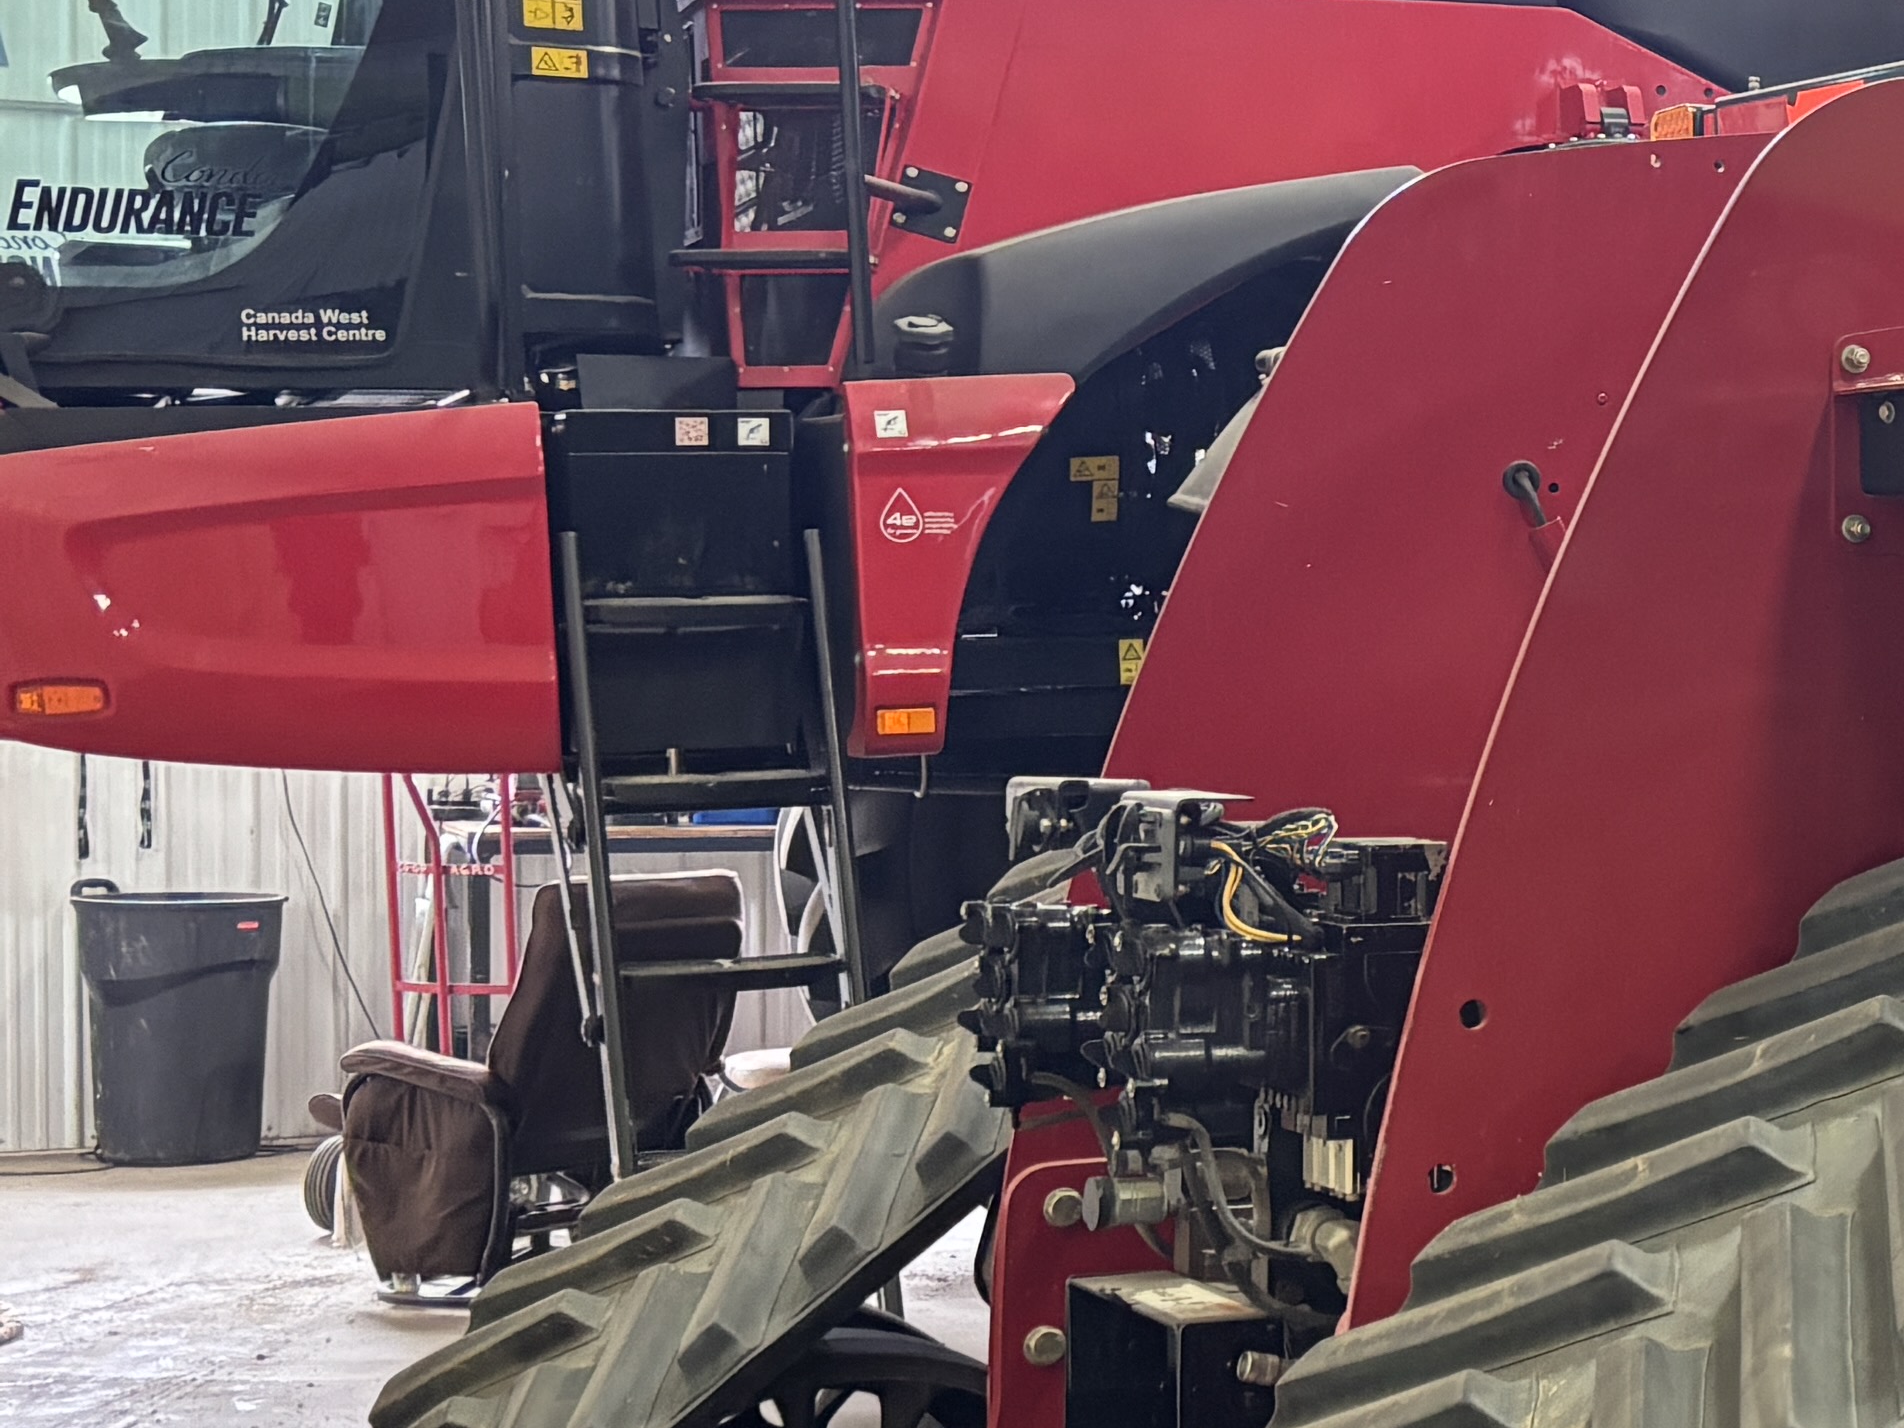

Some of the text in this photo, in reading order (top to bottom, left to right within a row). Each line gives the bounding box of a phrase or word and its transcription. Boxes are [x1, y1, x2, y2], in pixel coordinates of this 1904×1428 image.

[7, 178, 263, 237] ENDURANCE
[240, 308, 369, 325] Canada West
[241, 326, 386, 342] Harvest Centre
